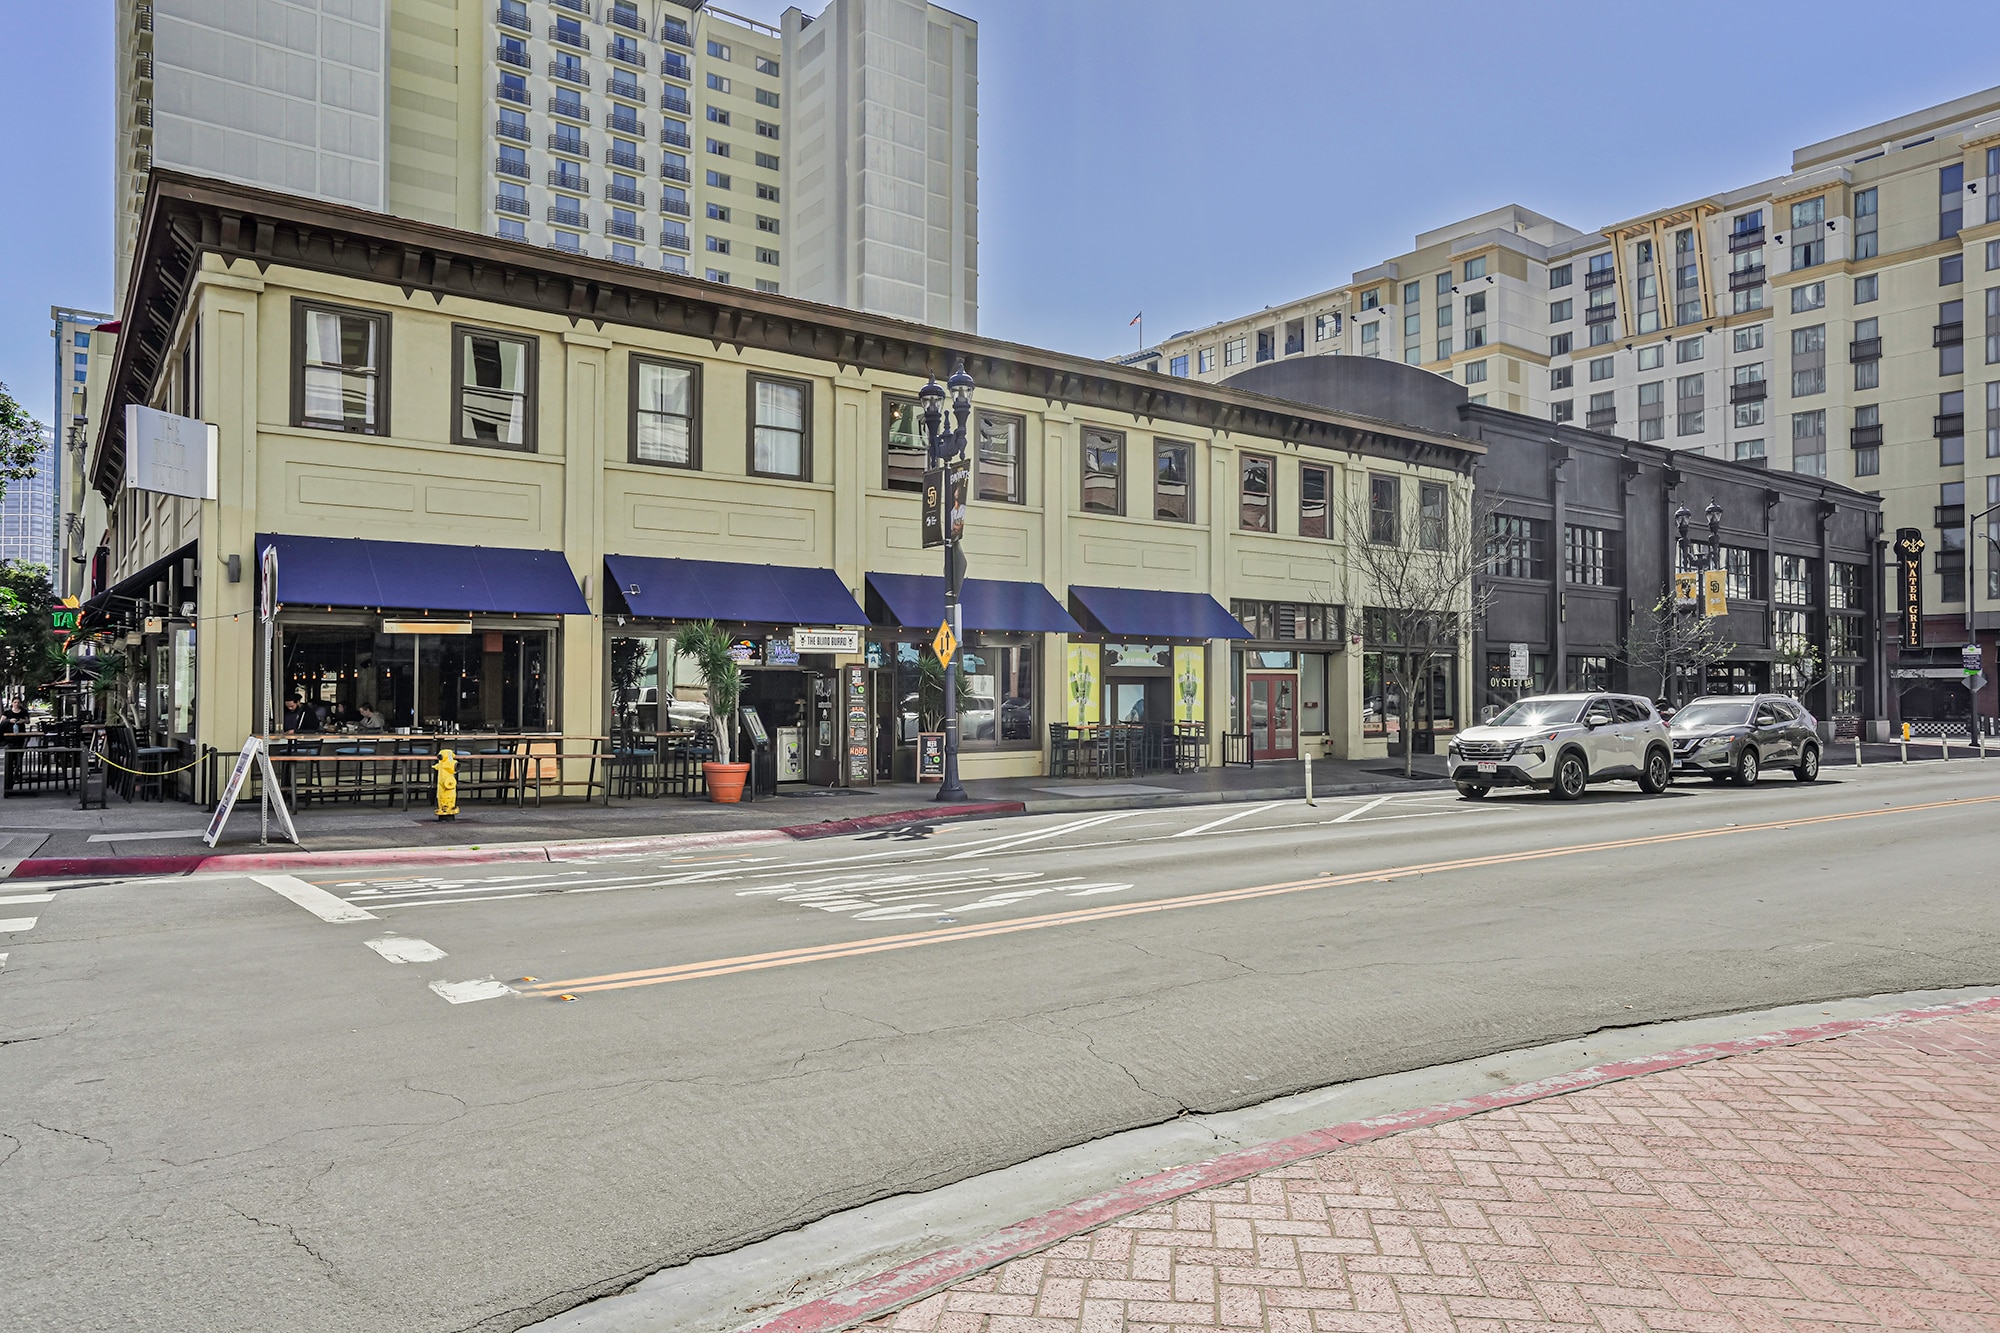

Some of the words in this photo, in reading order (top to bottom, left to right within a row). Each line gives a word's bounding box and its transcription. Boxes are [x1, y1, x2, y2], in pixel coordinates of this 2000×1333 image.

[1907, 561, 1918, 601] WATER
[1909, 605, 1918, 645] GRILL
[807, 636, 816, 646] THE
[817, 636, 830, 646] BLIND
[831, 637, 847, 646] BURRO
[1490, 677, 1522, 688] OYSTER
[849, 746, 868, 756] HOUR
[734, 867, 1134, 921] STOP
